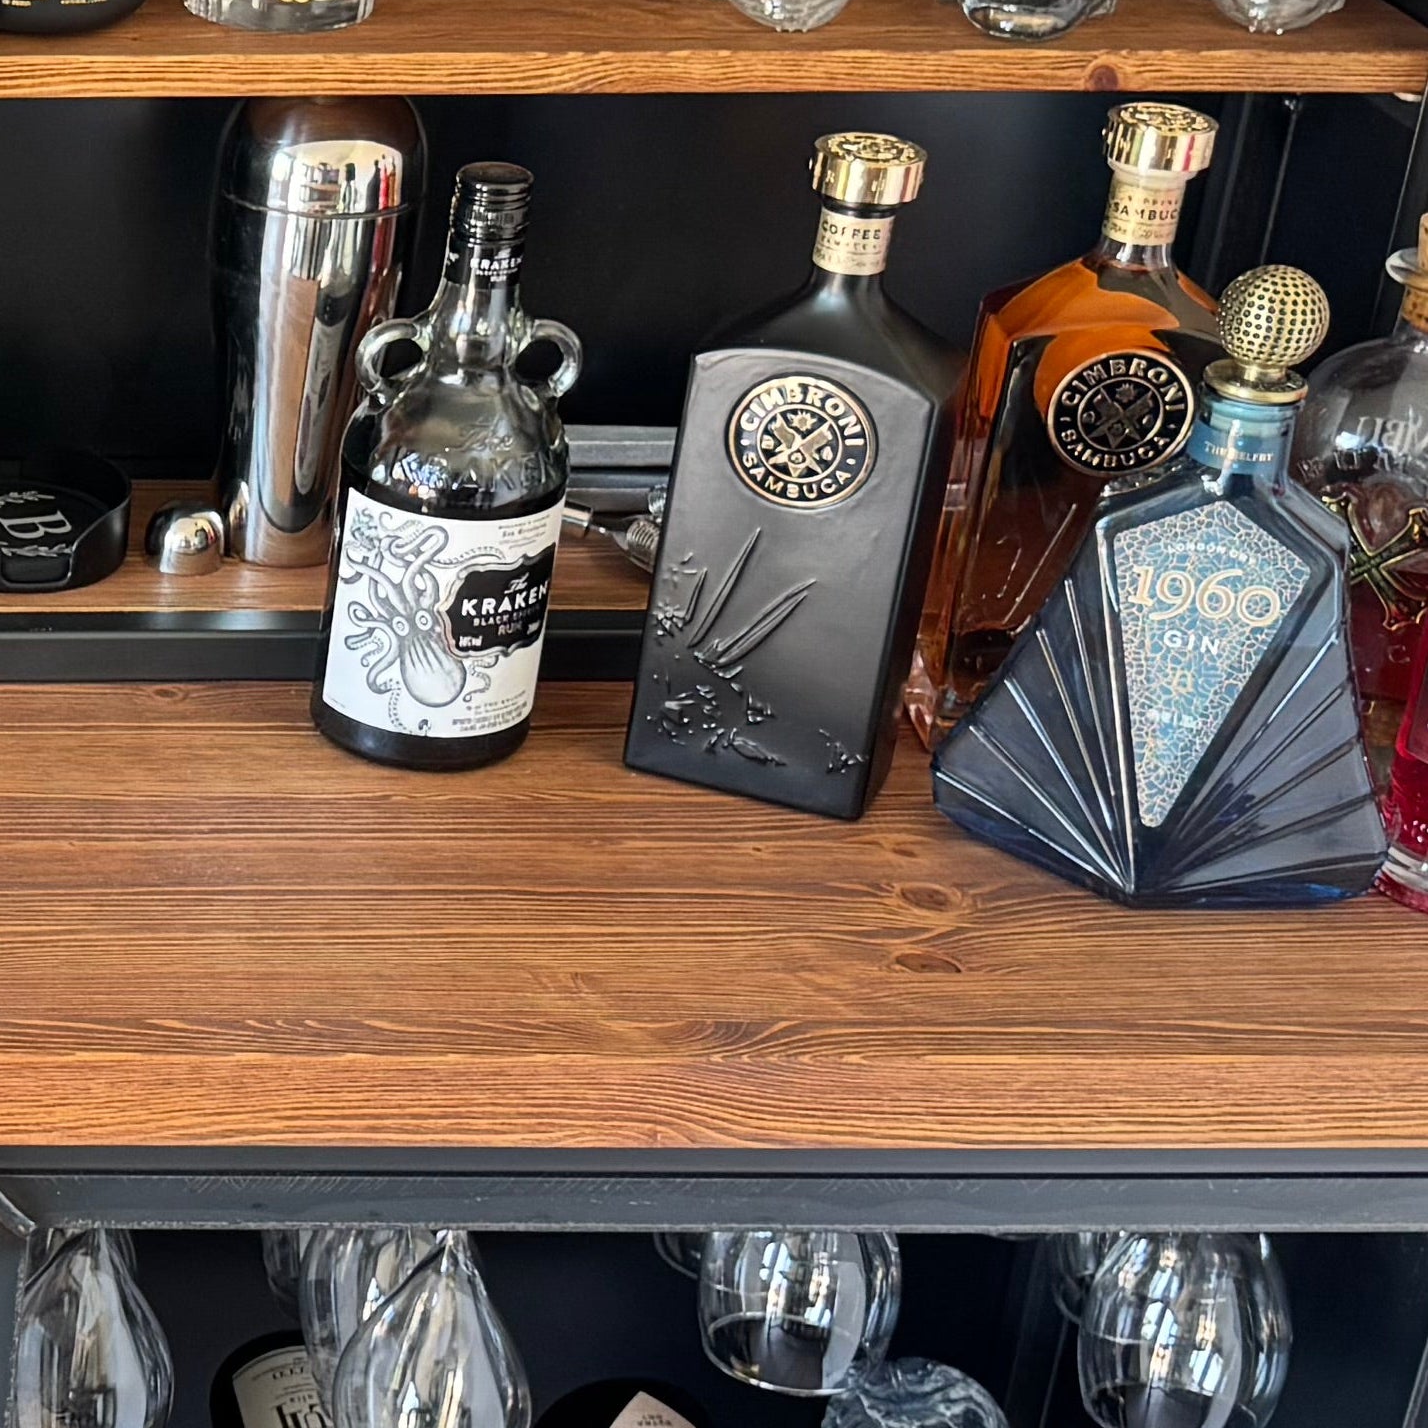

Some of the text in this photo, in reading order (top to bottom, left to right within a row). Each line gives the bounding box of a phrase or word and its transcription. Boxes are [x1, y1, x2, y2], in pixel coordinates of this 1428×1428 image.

[1061, 357, 1186, 412] CIMBRONI
[741, 385, 865, 447] CIMBRONI
[1060, 429, 1172, 470] SAMBUCA
[742, 454, 852, 500] SAMBUCA
[1167, 542, 1227, 556] LONDON
[461, 580, 550, 617] KRAKEN
[1128, 565, 1281, 627] 1960
[1163, 629, 1220, 655] GIN
